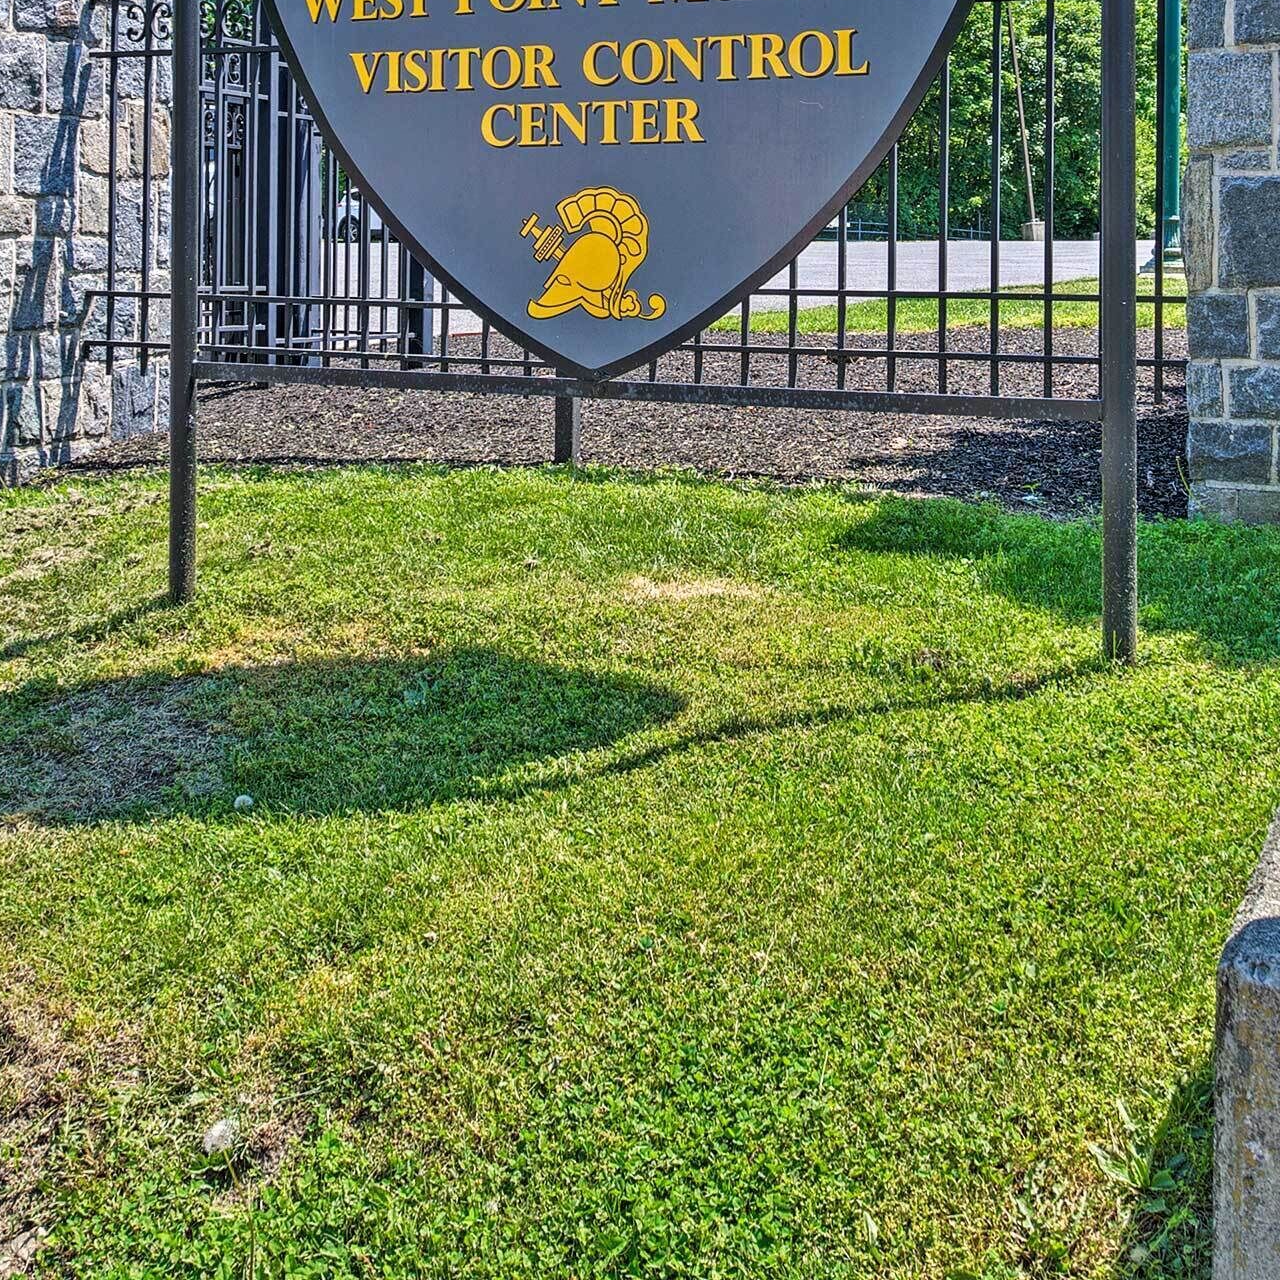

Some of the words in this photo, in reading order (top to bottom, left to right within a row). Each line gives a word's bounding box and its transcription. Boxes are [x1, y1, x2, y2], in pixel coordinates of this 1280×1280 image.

[349, 44, 559, 93] VISITOR
[582, 29, 869, 85] CONTROL
[480, 98, 705, 148] CENTER
